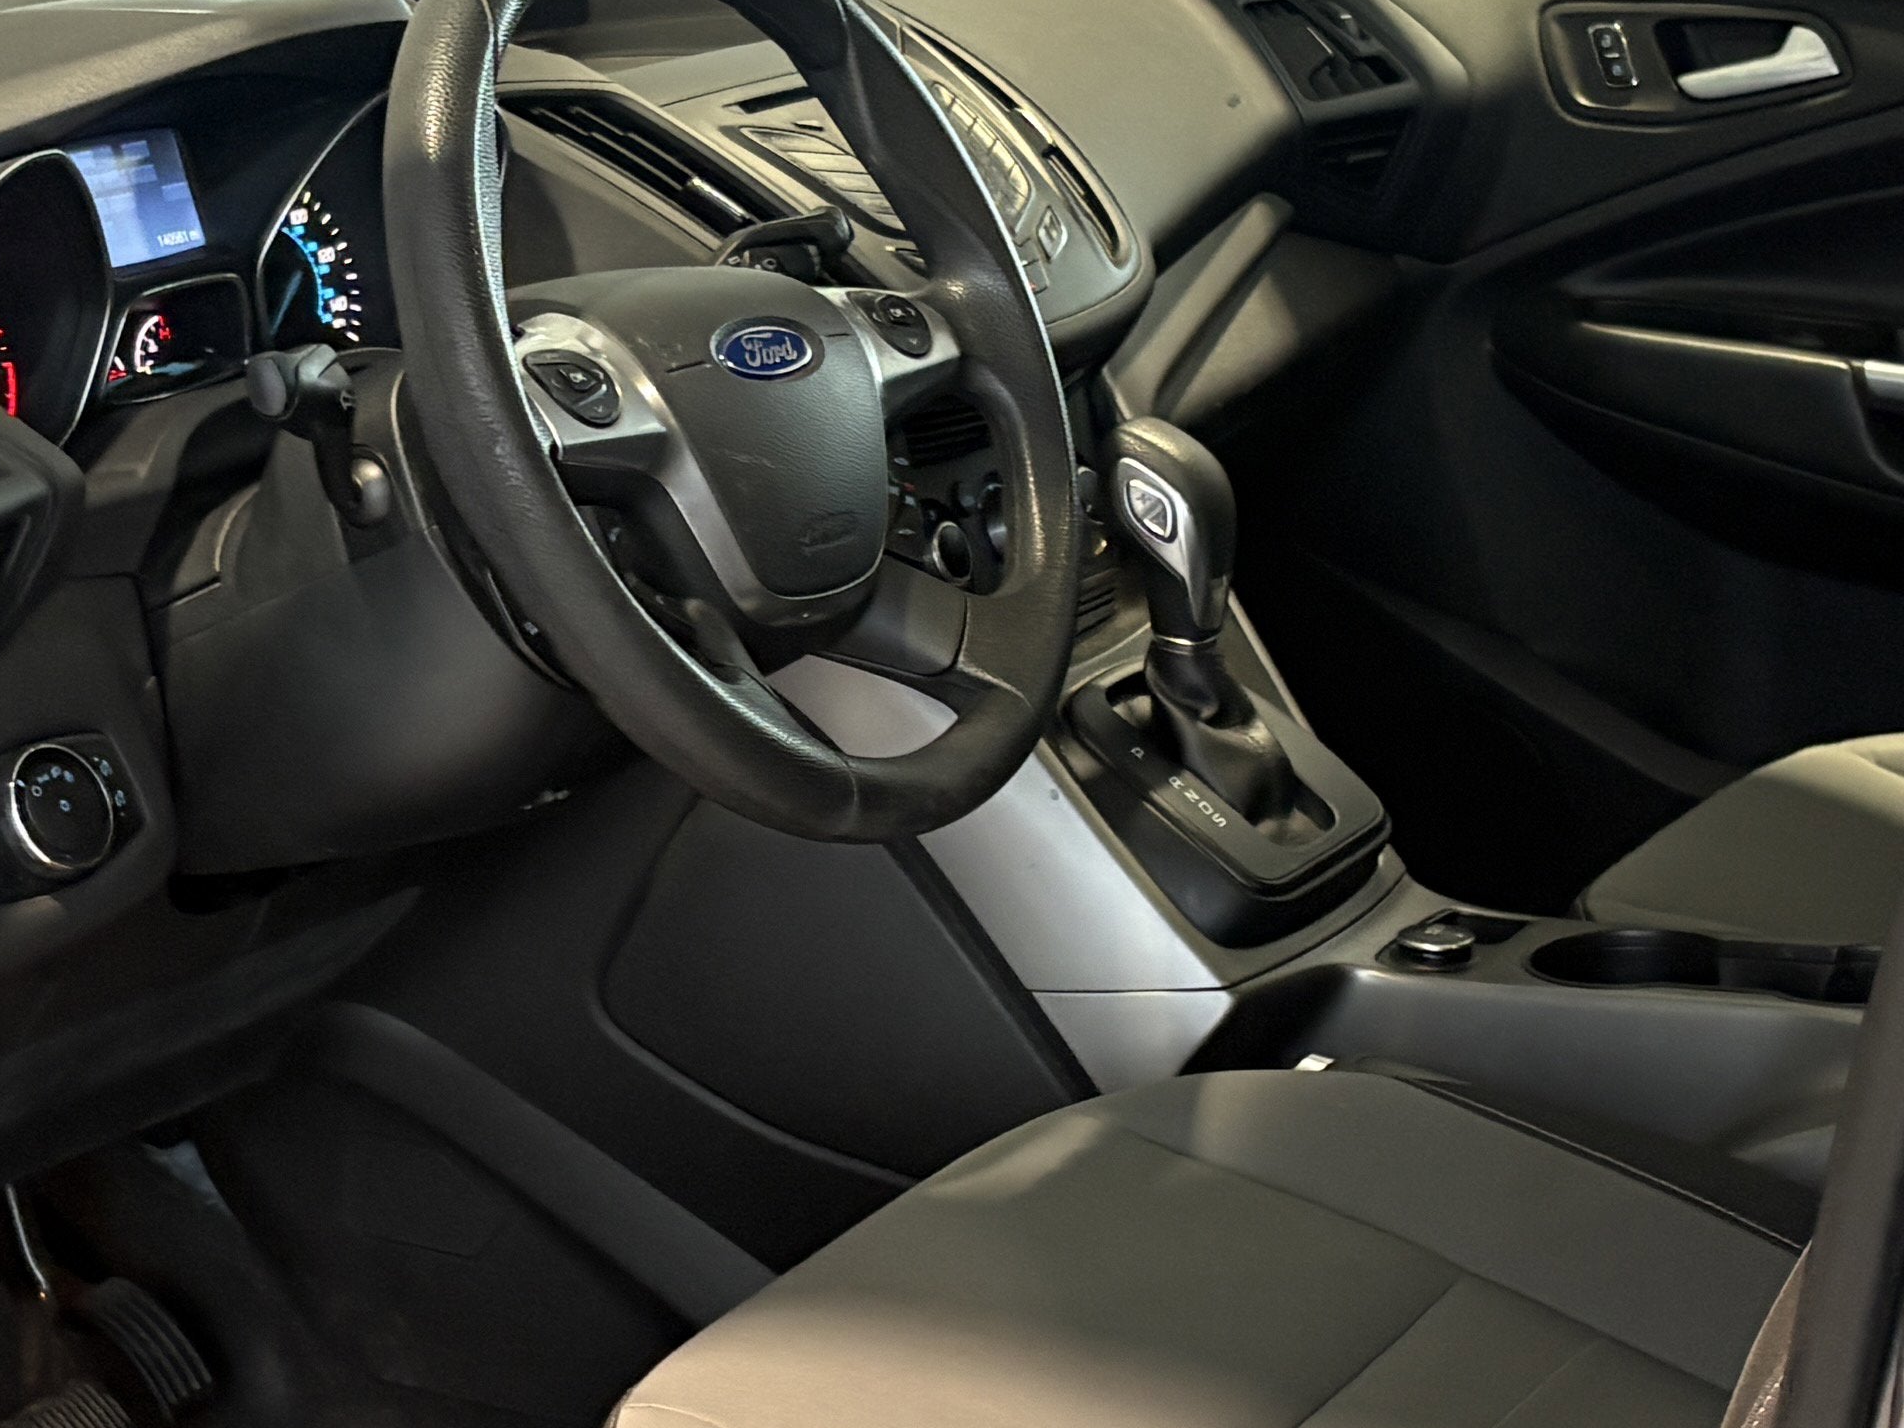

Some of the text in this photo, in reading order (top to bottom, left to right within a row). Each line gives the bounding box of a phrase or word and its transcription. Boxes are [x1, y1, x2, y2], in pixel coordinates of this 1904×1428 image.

[740, 332, 798, 368] Ford
[1168, 775, 1185, 790] R
[1183, 789, 1201, 804] N
[1211, 813, 1228, 827] S
